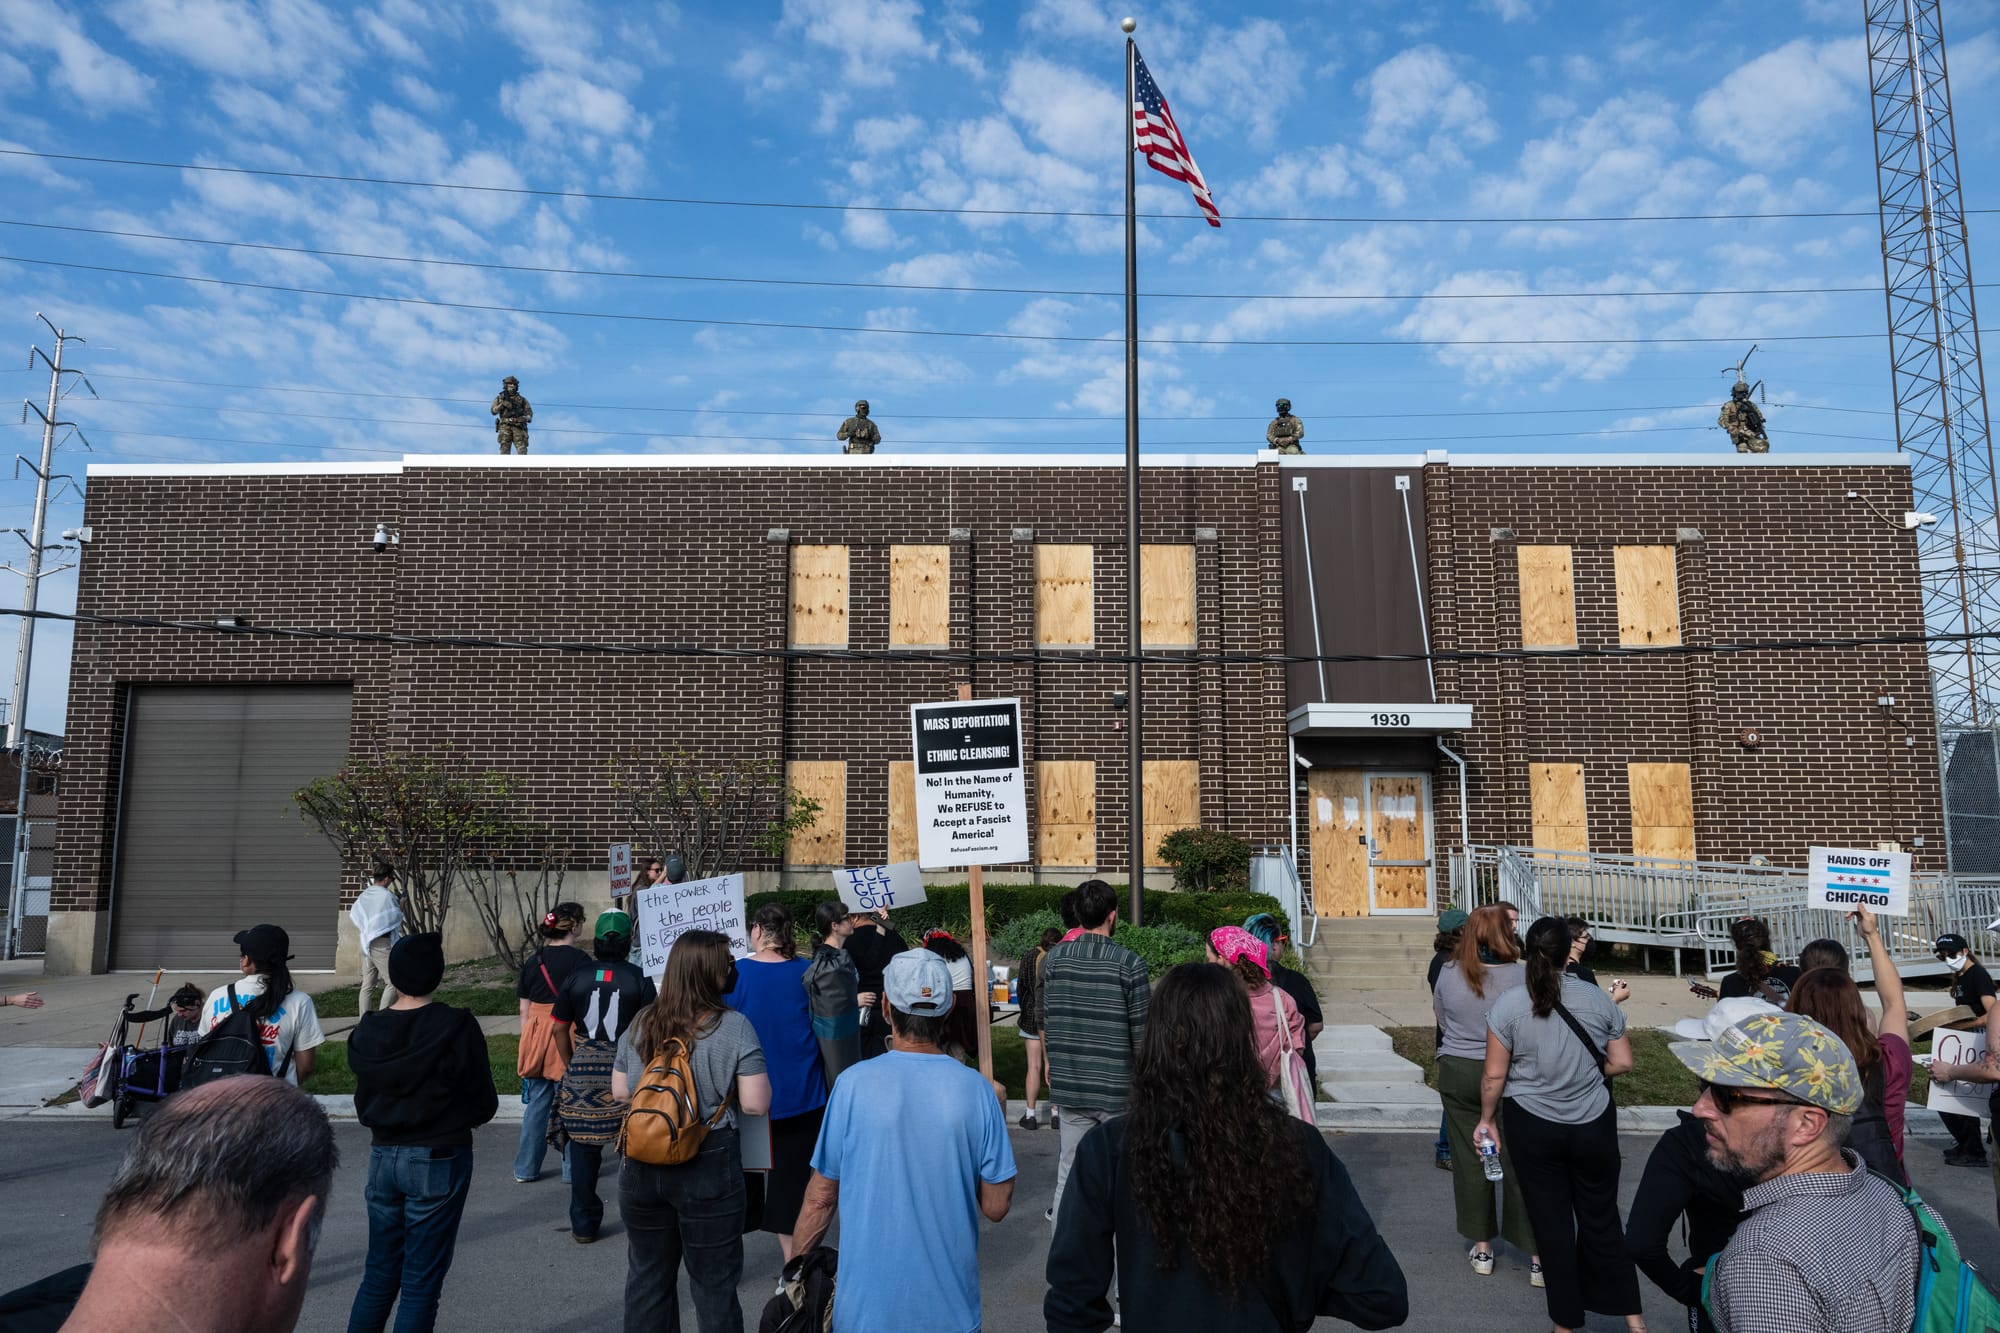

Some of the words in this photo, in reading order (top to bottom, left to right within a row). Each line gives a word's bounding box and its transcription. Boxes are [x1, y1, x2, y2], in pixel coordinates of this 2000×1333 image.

[923, 718, 949, 731] MASS
[952, 714, 1010, 729] DEPORTATION
[1371, 713, 1410, 726] 1930
[964, 735, 971, 743] =
[927, 749, 958, 762] ETHNIC
[959, 745, 1010, 760] CLEANSING!
[926, 777, 942, 788] No!
[944, 776, 953, 786] In
[955, 775, 972, 785] the
[973, 774, 1001, 784] Name
[1003, 772, 1013, 782] of
[944, 788, 995, 800] Humanity,
[937, 804, 953, 813] We
[955, 801, 993, 812] REFUSE
[994, 802, 1005, 810] to
[933, 818, 967, 828] Accept
[976, 814, 1011, 825] Fascist
[952, 828, 994, 840] America!
[950, 845, 998, 853] RefuseFascism.org
[616, 851, 624, 862] NO
[1827, 855, 1866, 866] HANDS
[1869, 857, 1891, 868] OFF
[846, 865, 889, 883] ICE
[644, 892, 670, 908] the
[717, 878, 730, 895] of
[854, 879, 891, 897] GET
[860, 891, 895, 909] OUT
[1825, 891, 1889, 906] CHICAGO
[658, 910, 683, 927] the
[692, 899, 732, 923] people
[647, 933, 657, 947] is
[715, 917, 739, 931] than
[646, 954, 665, 968] the
